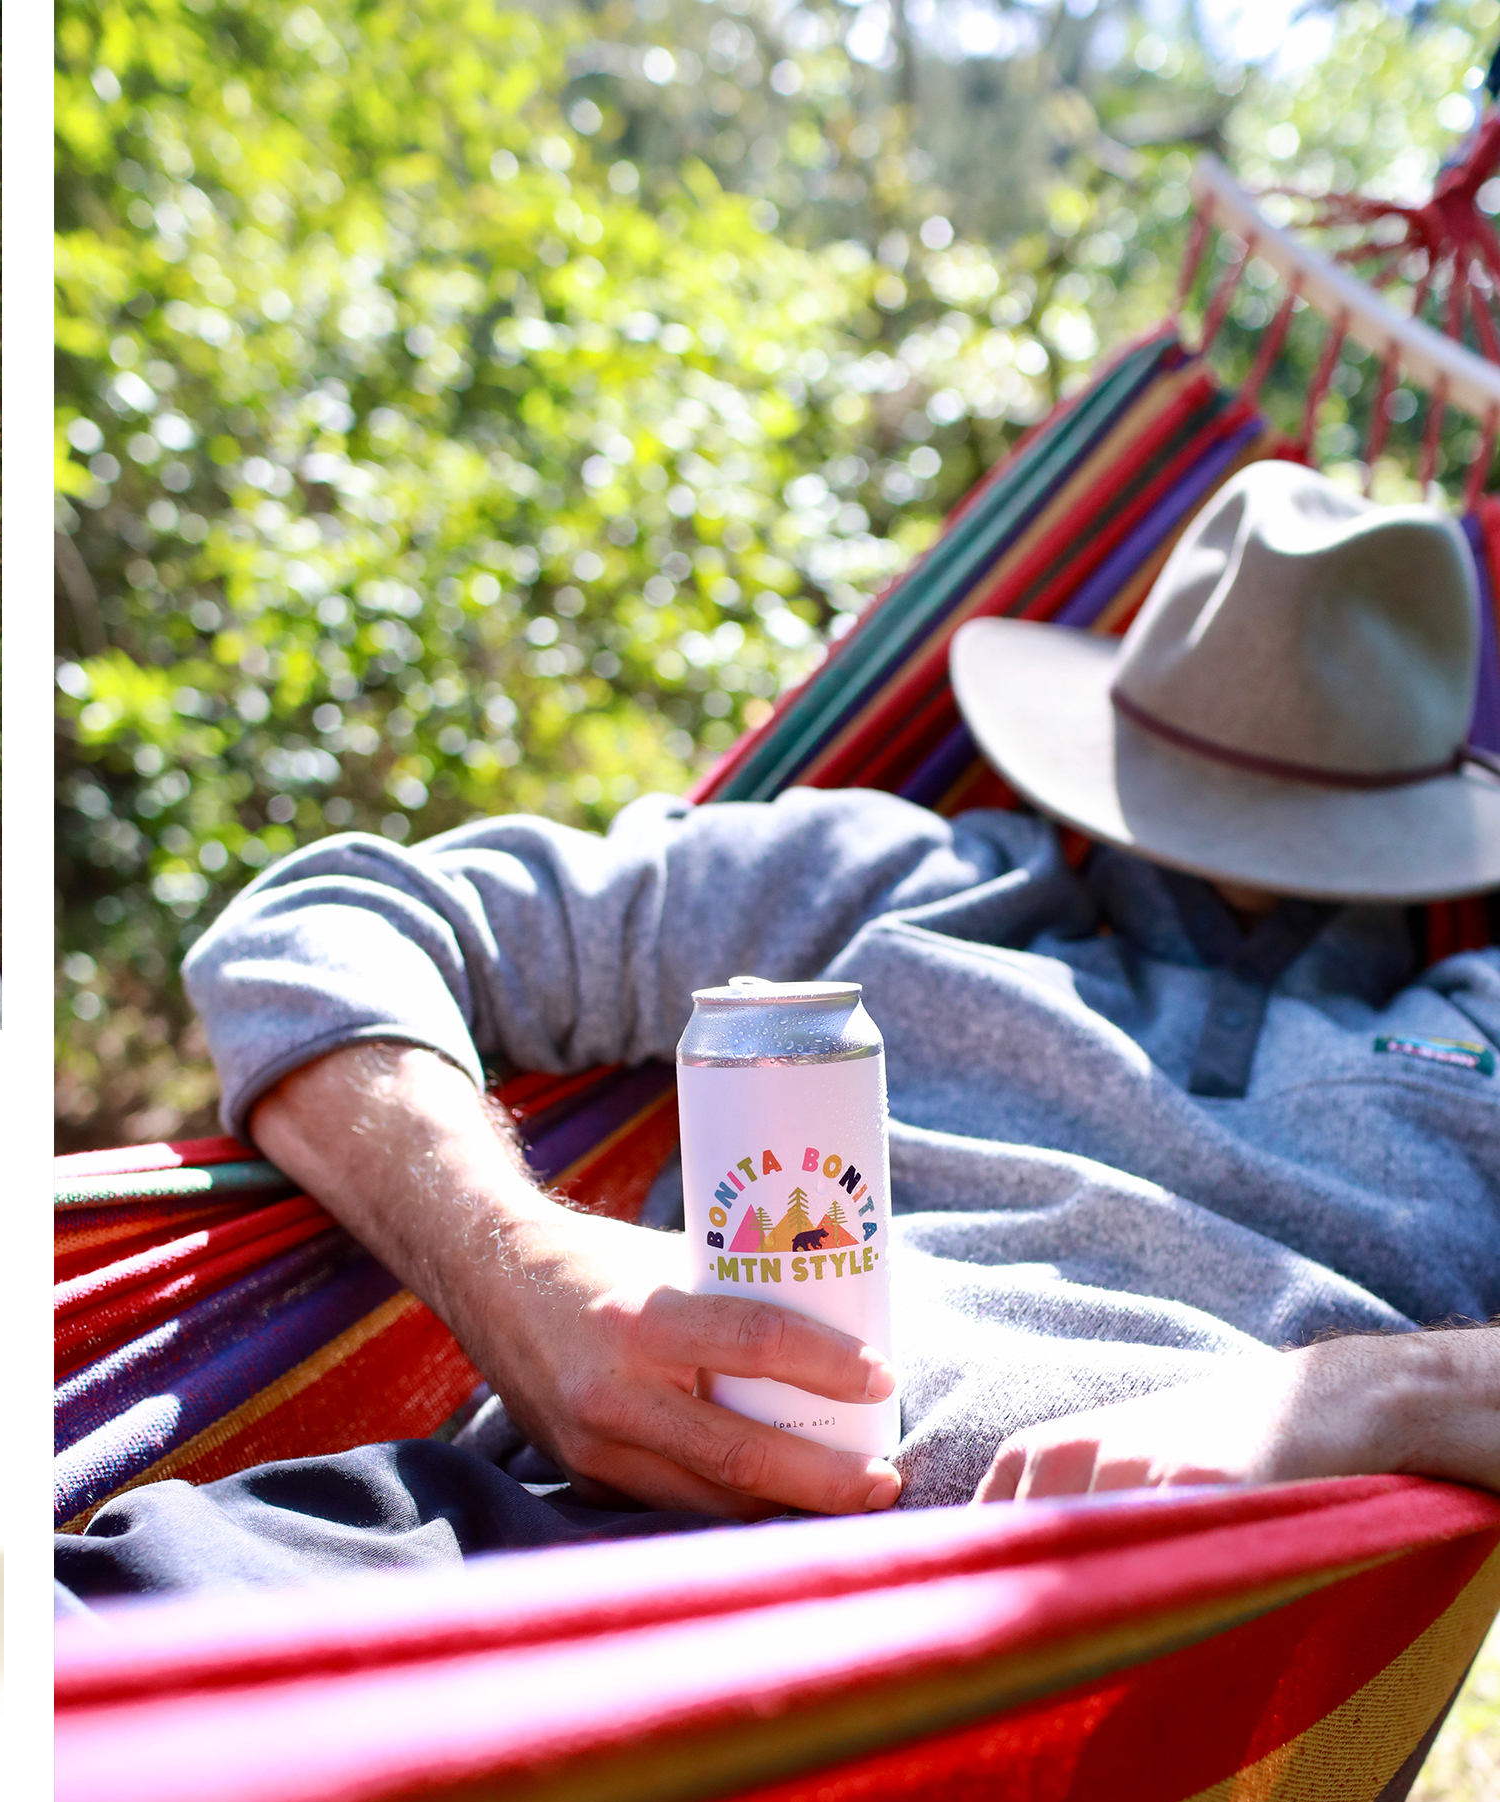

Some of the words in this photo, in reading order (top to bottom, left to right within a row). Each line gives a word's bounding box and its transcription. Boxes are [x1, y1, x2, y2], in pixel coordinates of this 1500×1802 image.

[706, 1149, 783, 1250] BONITA
[802, 1147, 879, 1242] BONITA
[717, 1255, 782, 1283] MTN
[791, 1246, 874, 1283] STYLE
